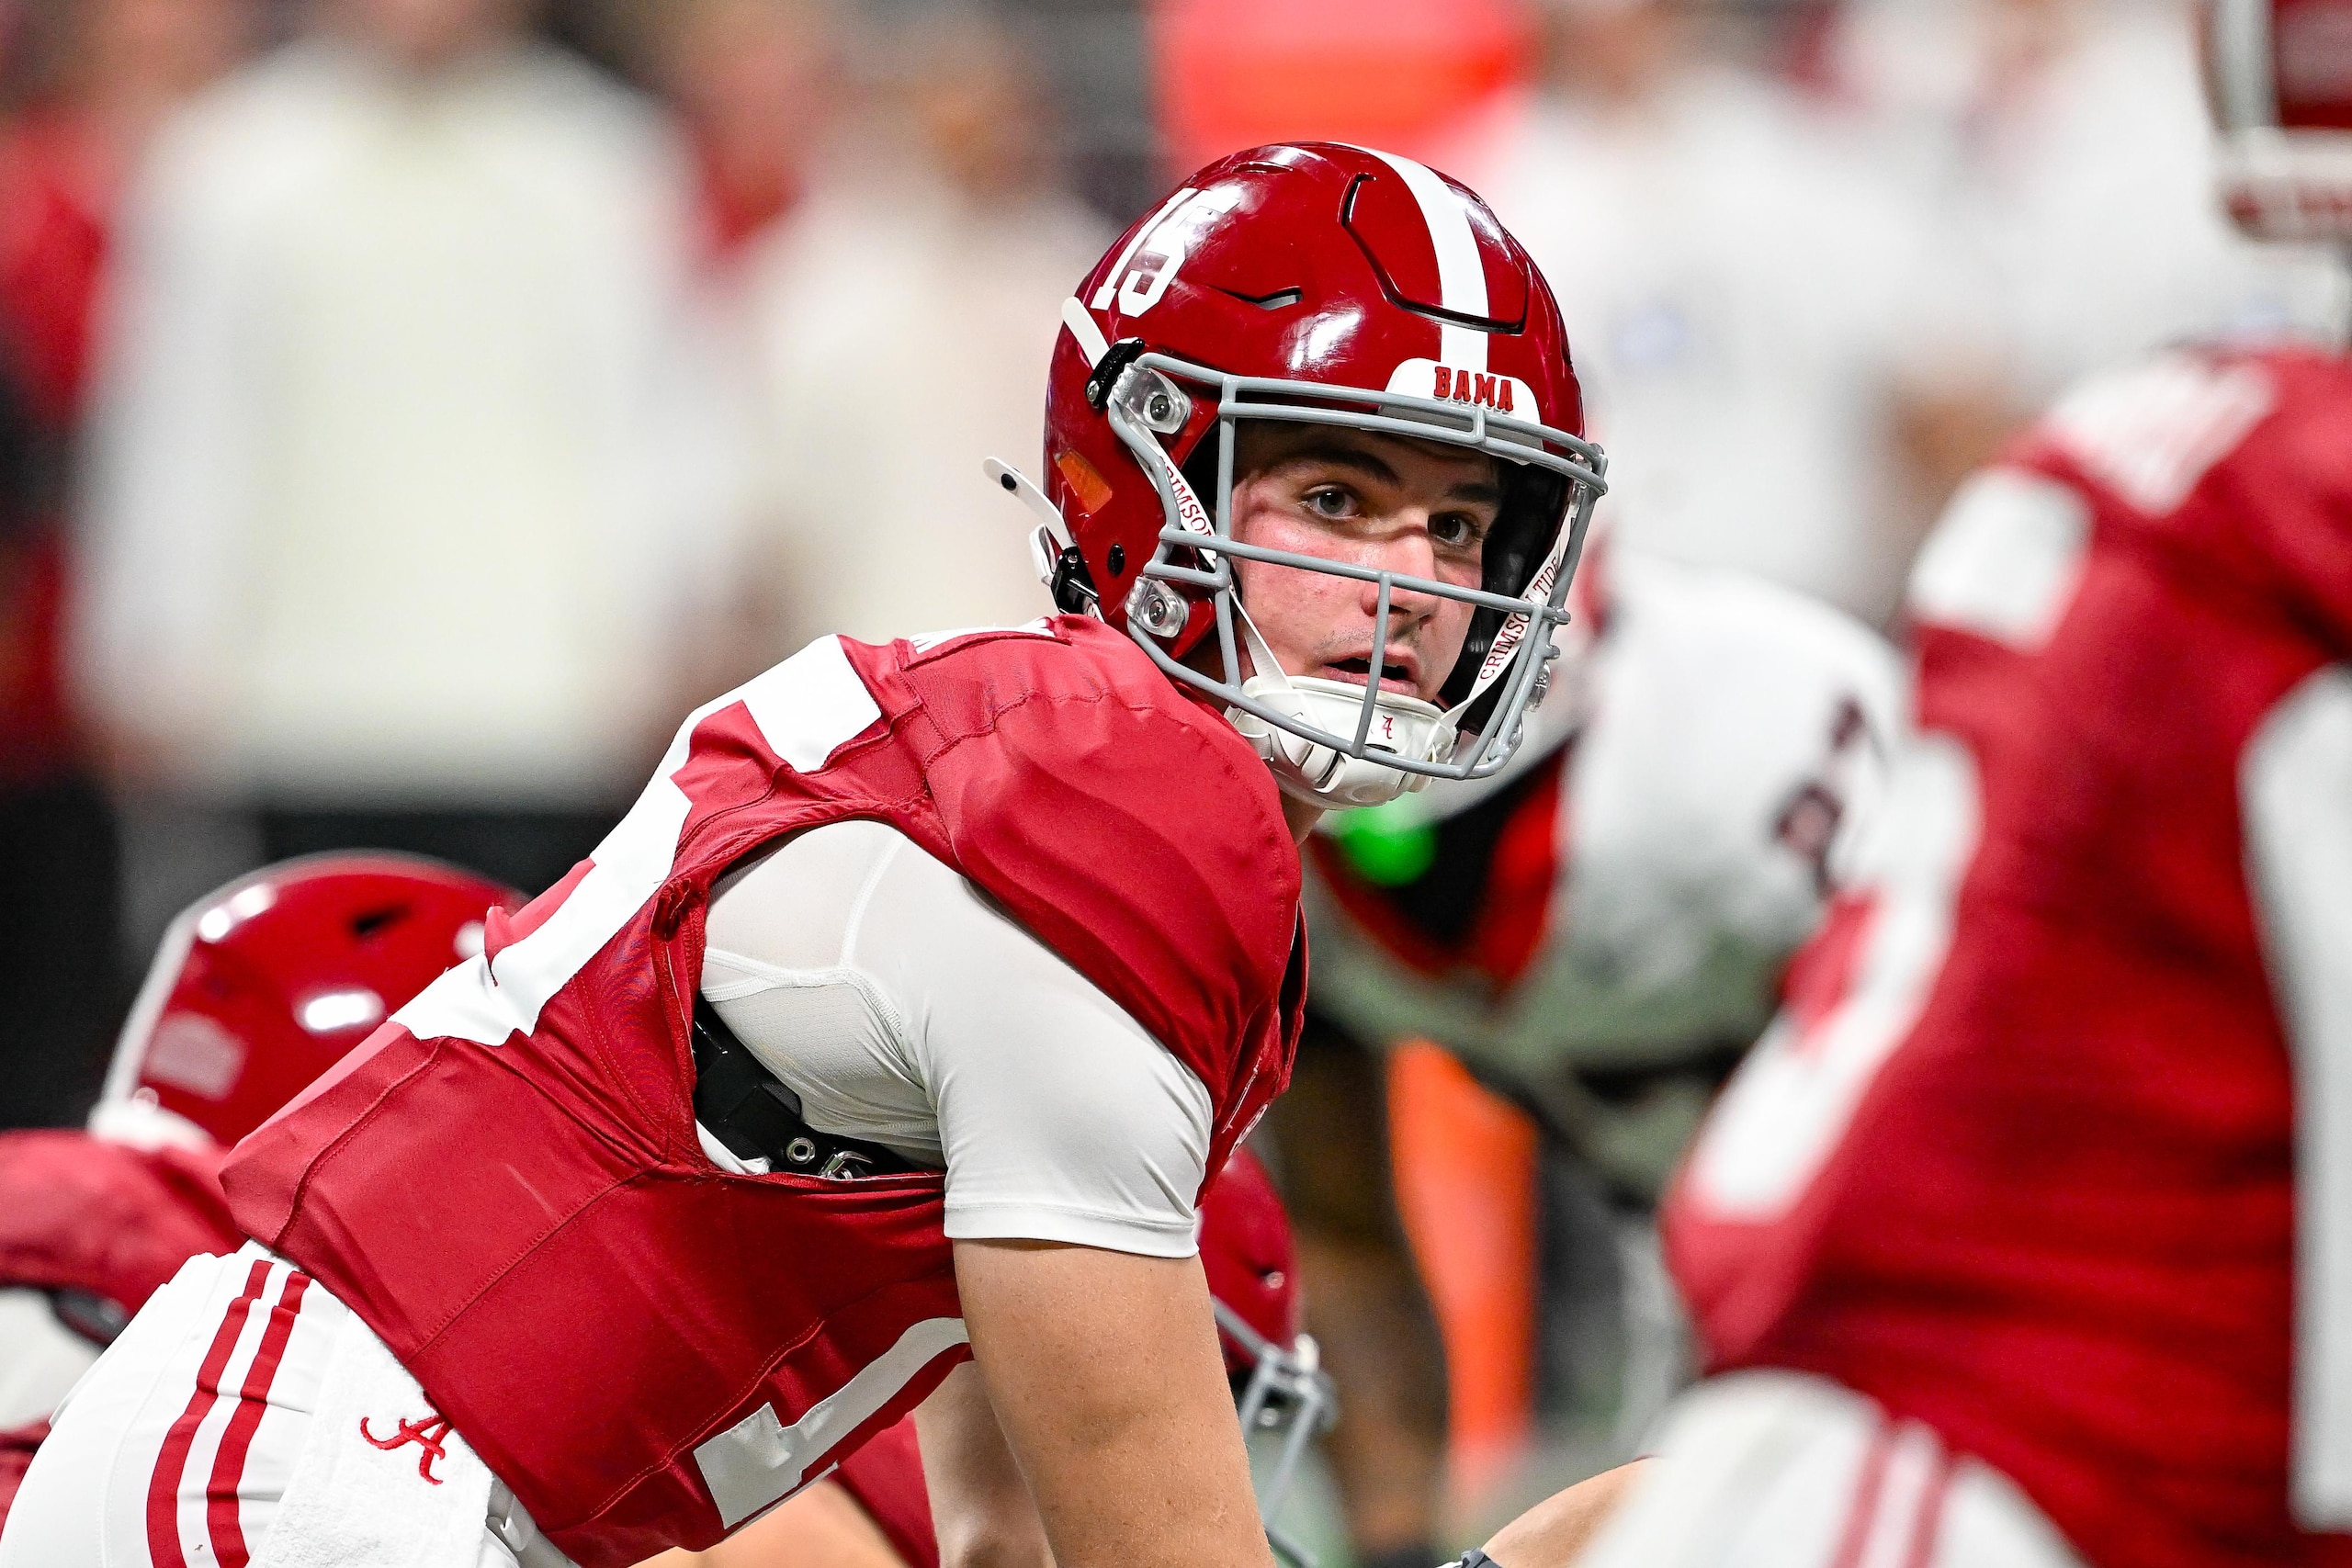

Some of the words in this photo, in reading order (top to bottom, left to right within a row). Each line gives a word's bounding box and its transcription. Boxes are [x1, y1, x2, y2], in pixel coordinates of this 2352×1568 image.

[1090, 186, 1241, 318] 15
[1433, 366, 1514, 412] BAMA
[1480, 593, 1533, 680] CRIMSO
